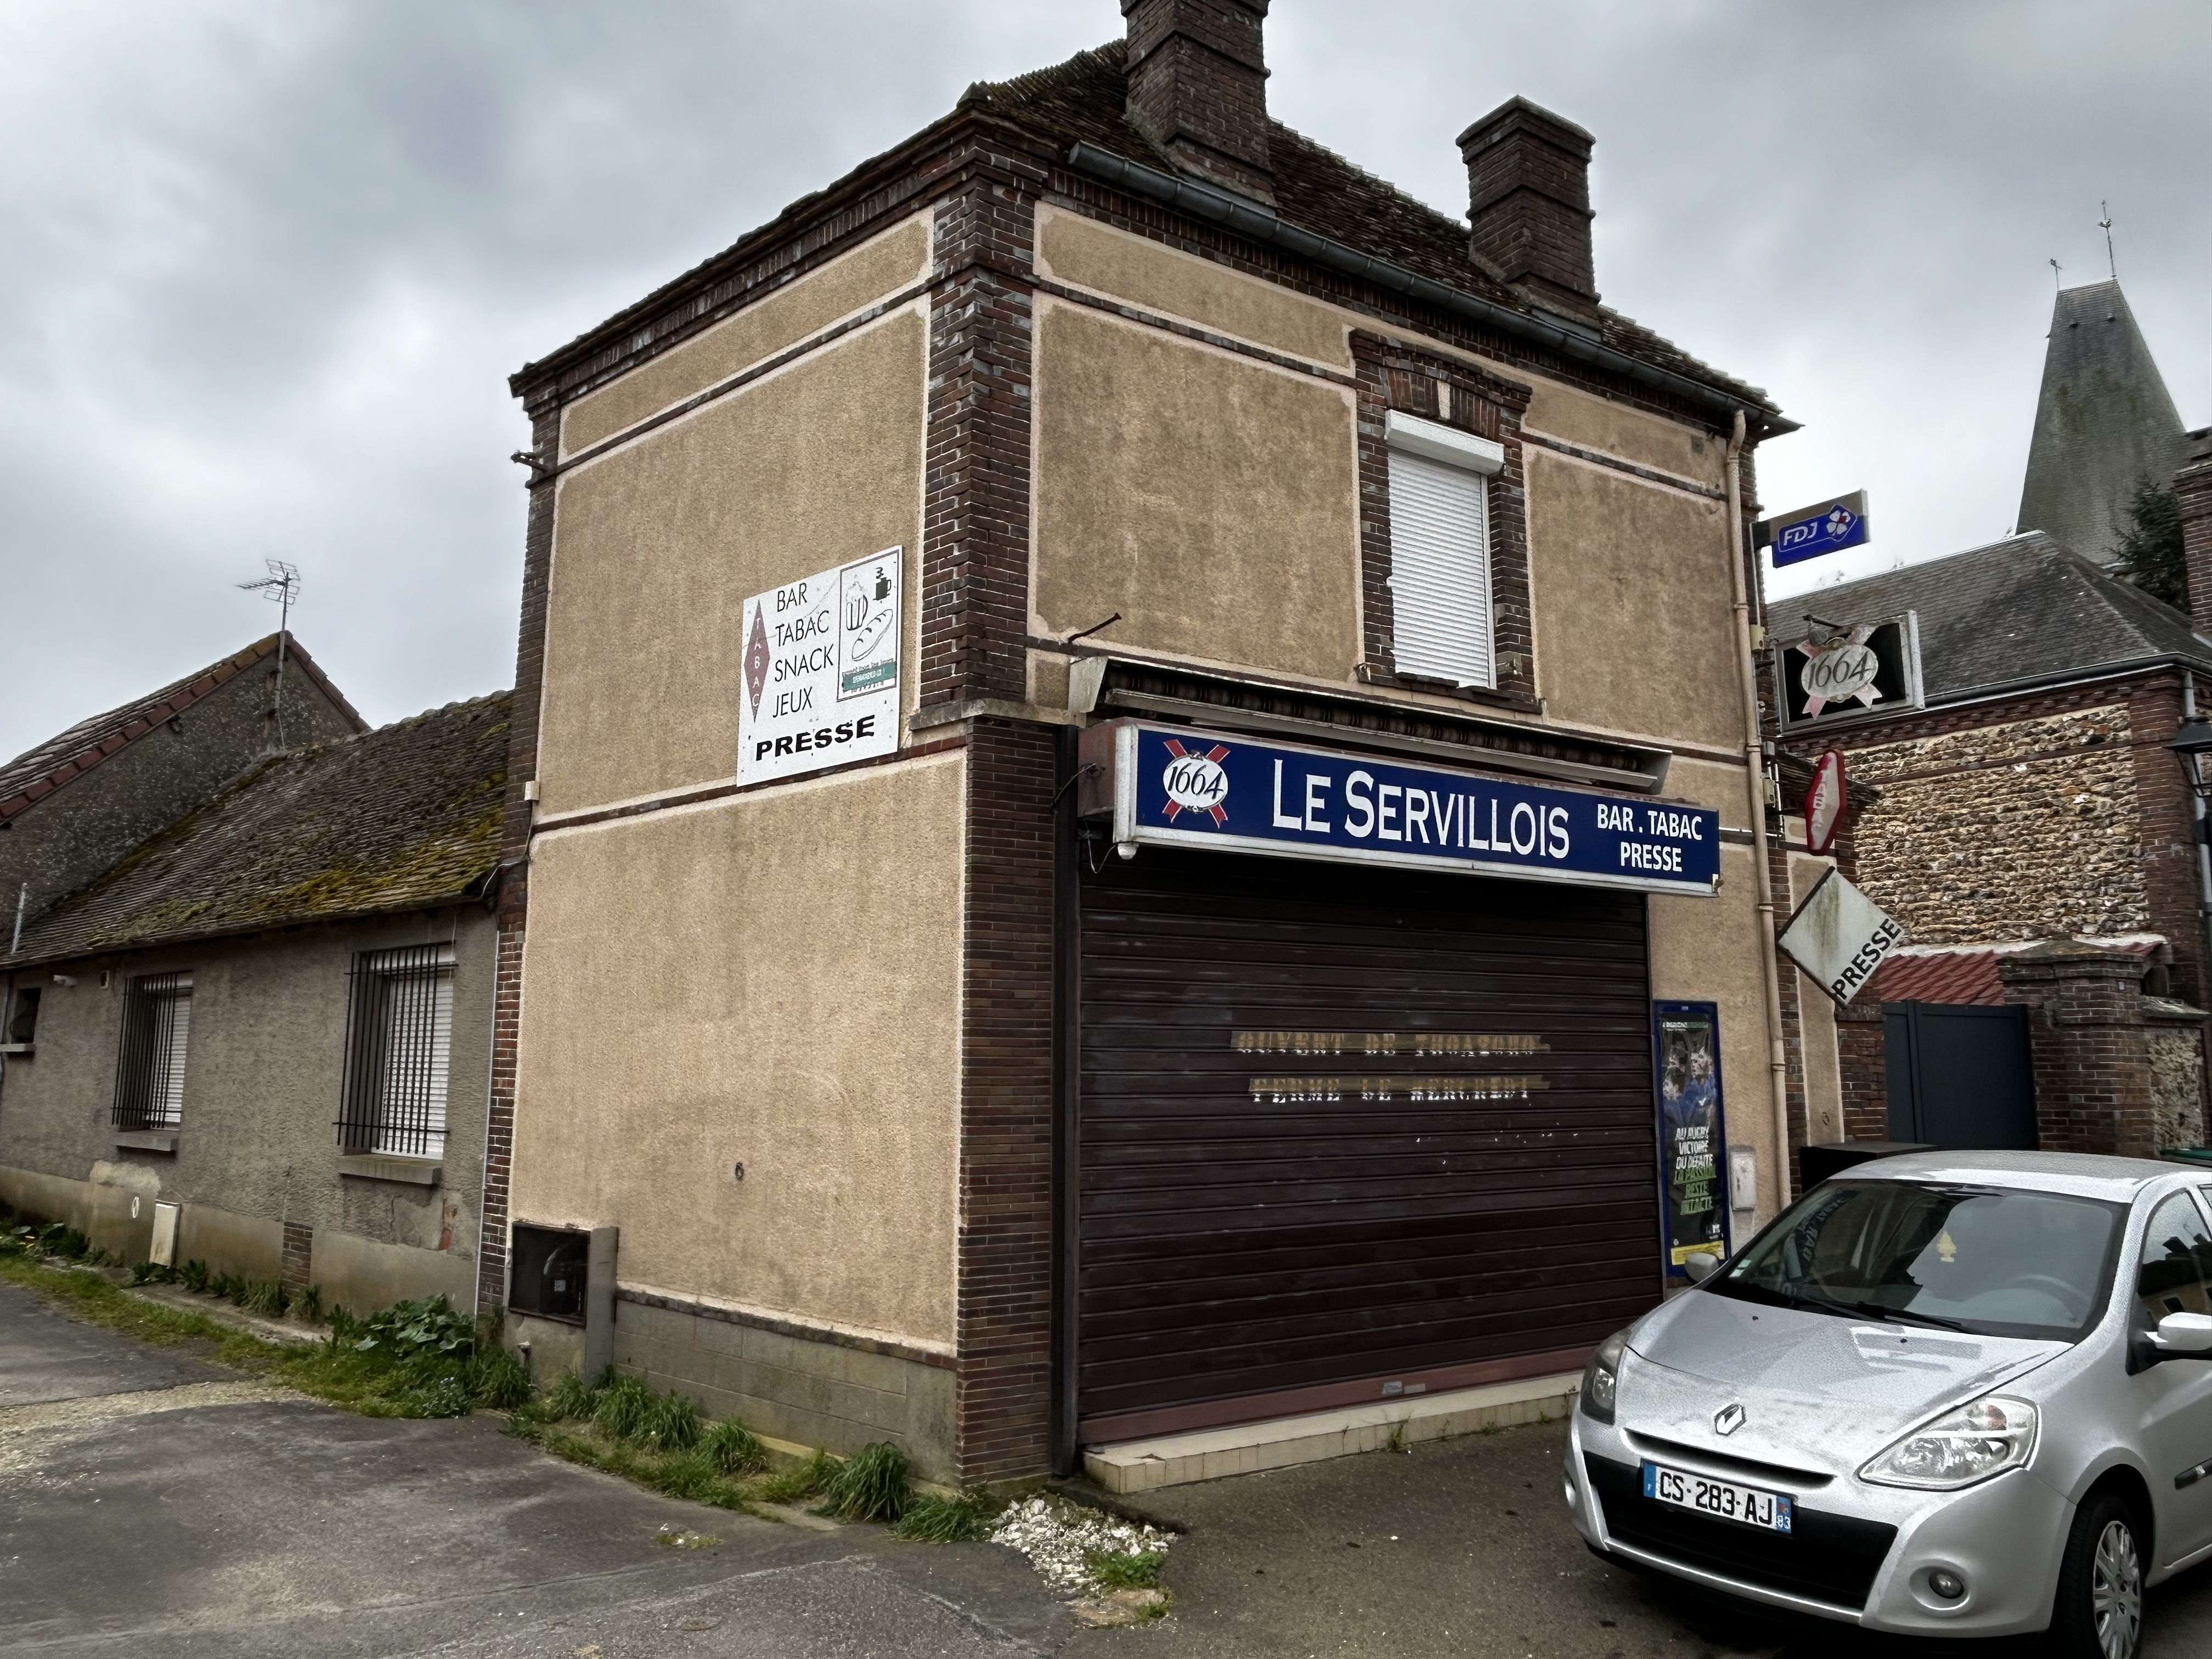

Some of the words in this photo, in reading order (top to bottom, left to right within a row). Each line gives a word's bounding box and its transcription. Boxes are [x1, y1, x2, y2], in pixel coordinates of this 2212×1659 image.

[1784, 522, 1818, 546] FDJ
[777, 582, 807, 612] BAR
[775, 610, 830, 647] TABAC
[752, 617, 761, 707] TABAC
[775, 644, 834, 682] SNACK
[1808, 649, 1873, 689] 1664
[772, 686, 812, 718] JEUX
[756, 715, 874, 761] PRESSE
[1167, 762, 1224, 799] 1664
[1273, 759, 1330, 833] LE
[1345, 770, 1570, 859] SERVILLOIS
[1598, 803, 1634, 832] BAR
[1647, 810, 1702, 840] TABAC
[1621, 842, 1683, 872] PRESSE
[1831, 918, 1901, 1000] PRESSE
